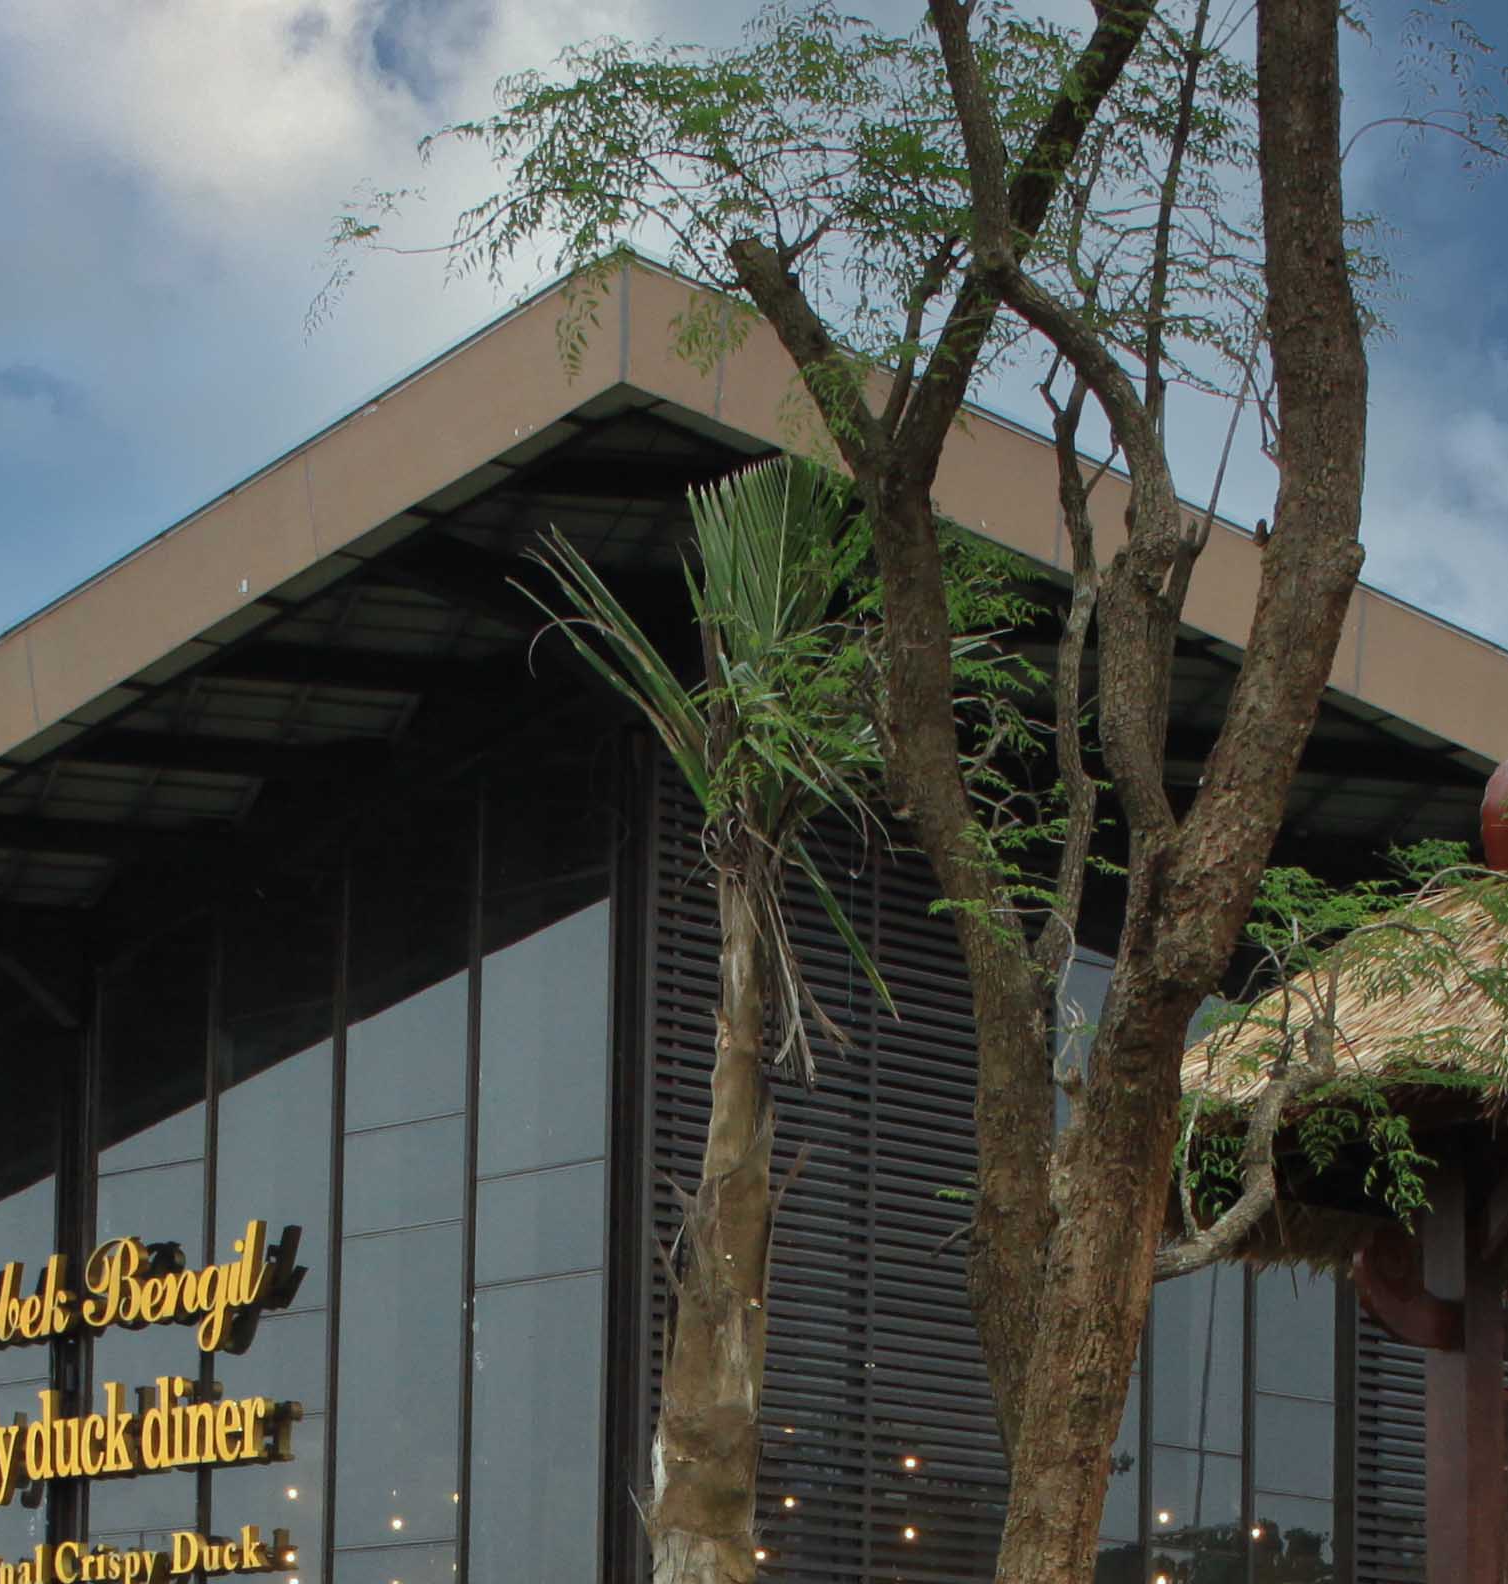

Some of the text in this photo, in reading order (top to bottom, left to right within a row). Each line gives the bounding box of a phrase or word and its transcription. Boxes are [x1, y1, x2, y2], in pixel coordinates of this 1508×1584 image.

[83, 1220, 266, 1352] Bengil
[24, 1382, 133, 1480] duck
[141, 1376, 266, 1468] diner
[171, 1525, 263, 1574] Duck
